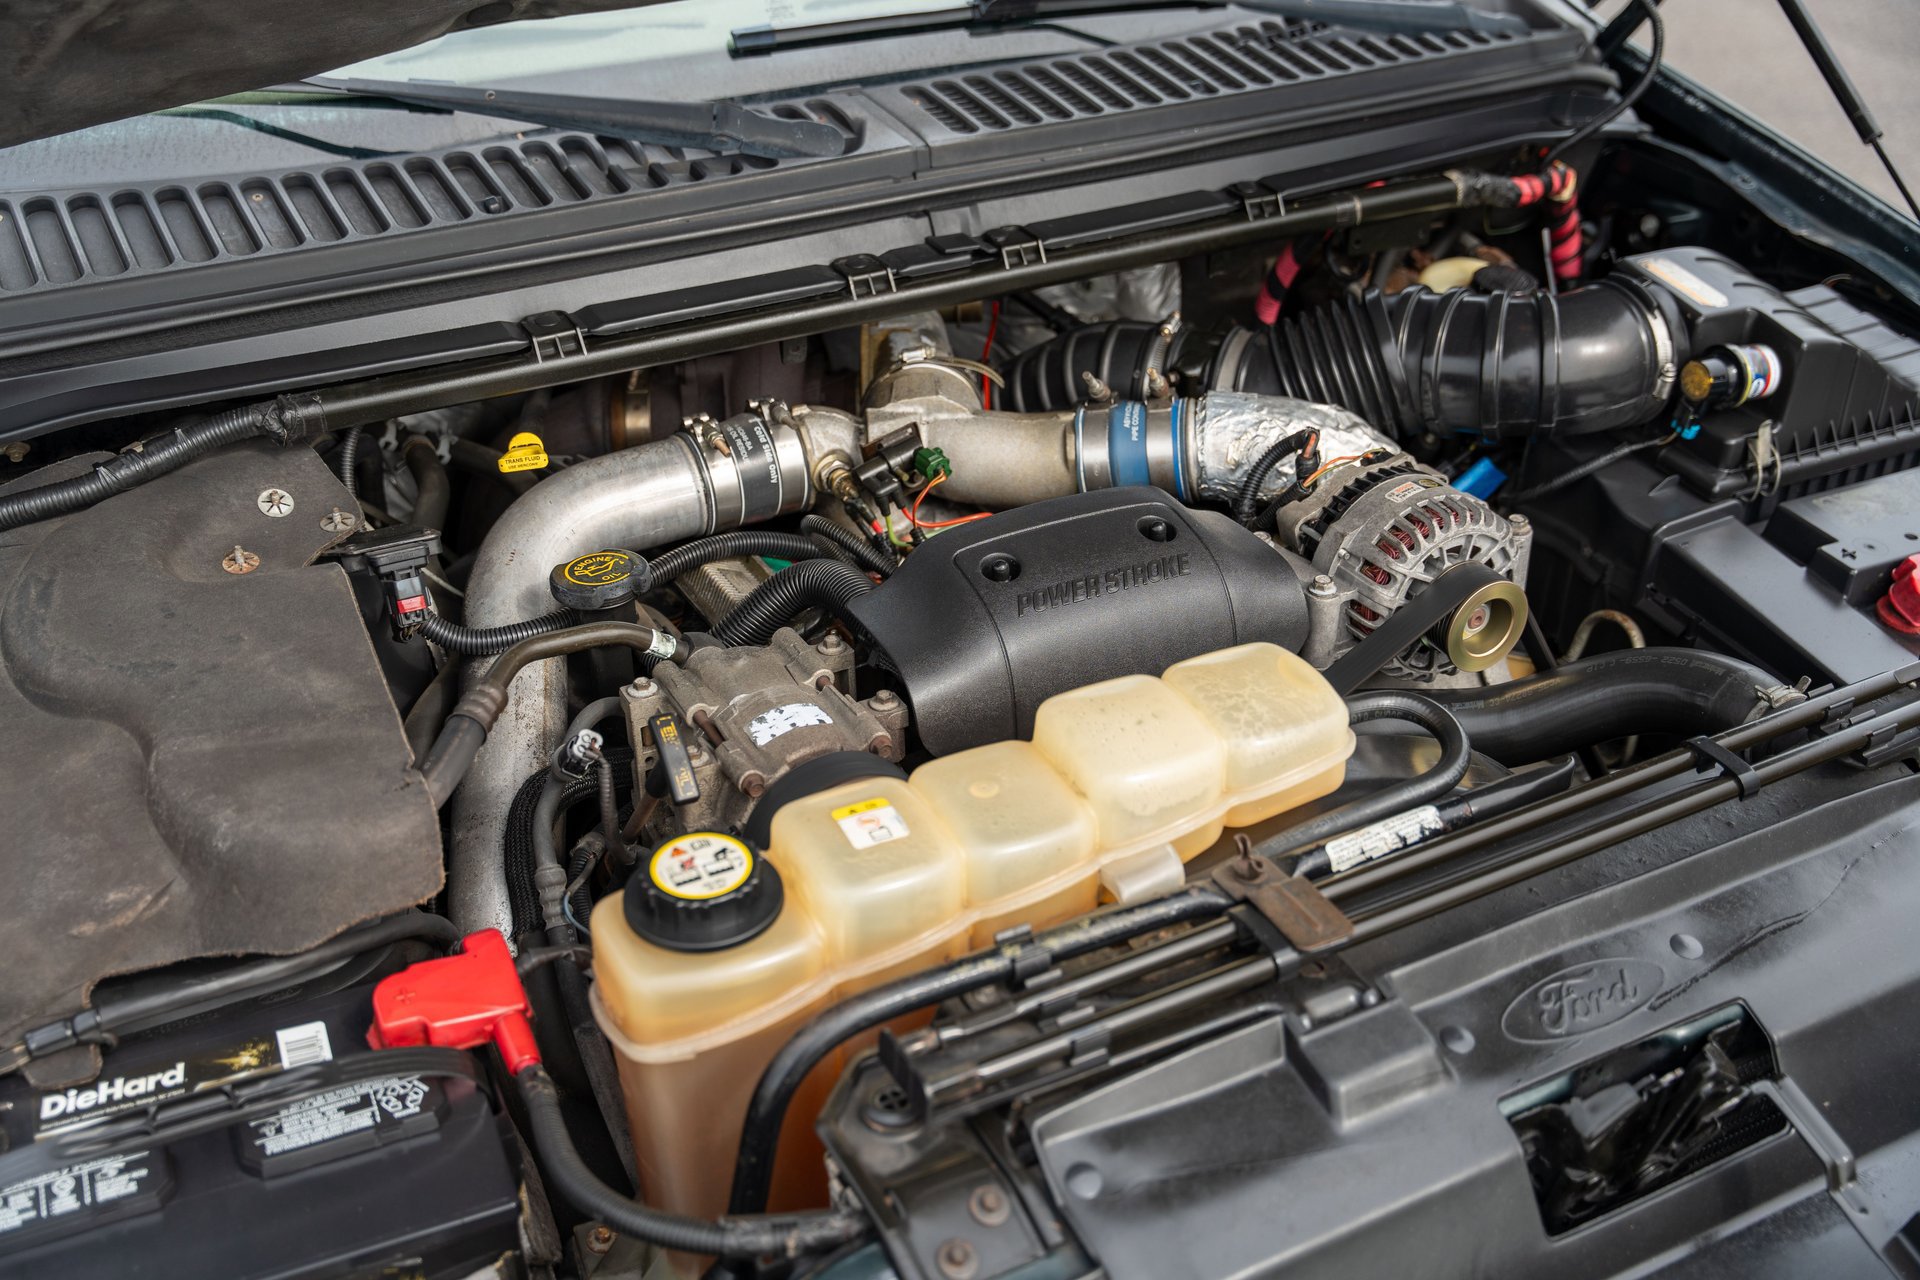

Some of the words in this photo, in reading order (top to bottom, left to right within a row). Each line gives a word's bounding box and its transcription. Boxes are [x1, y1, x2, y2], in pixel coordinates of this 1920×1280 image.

[574, 556, 613, 571] ENGINE
[602, 572, 622, 581] OIL
[1017, 574, 1101, 617] POWER
[1105, 553, 1191, 594] STROKE
[1540, 967, 1637, 1034] Ford
[40, 1061, 186, 1120] DieHard
